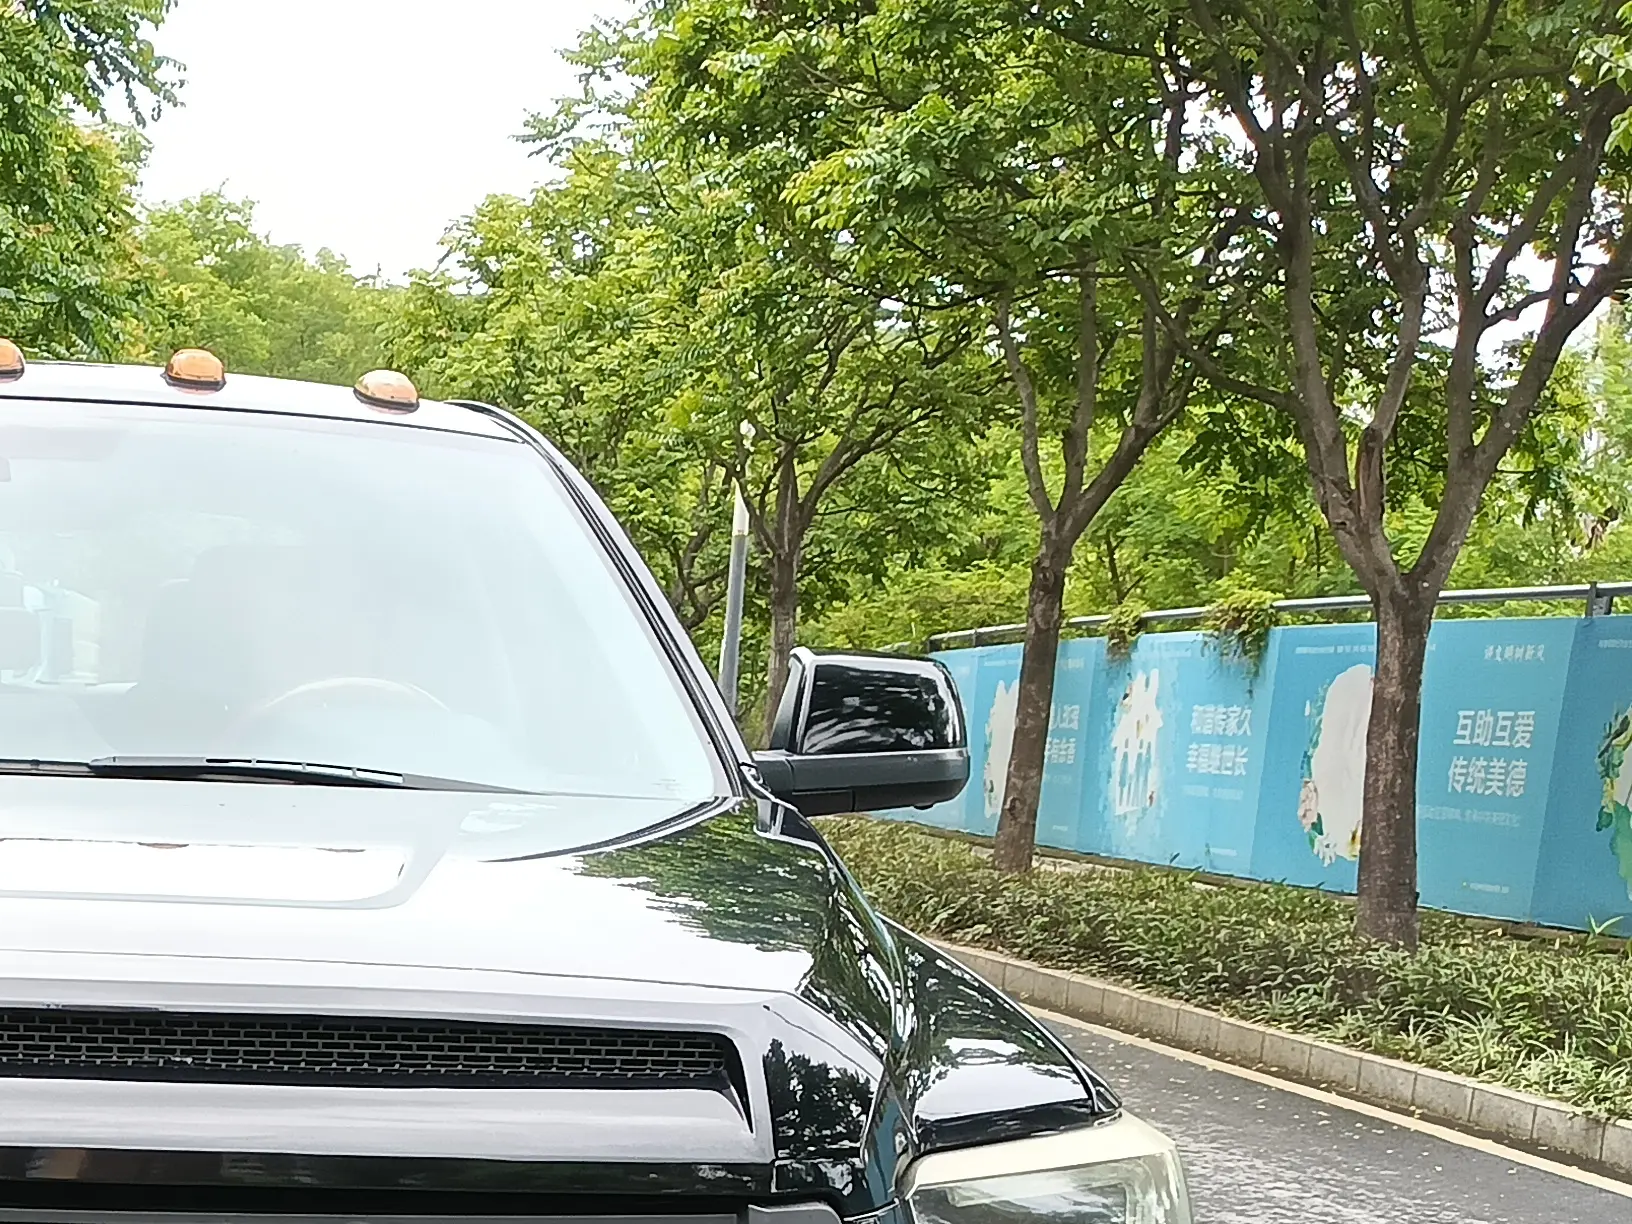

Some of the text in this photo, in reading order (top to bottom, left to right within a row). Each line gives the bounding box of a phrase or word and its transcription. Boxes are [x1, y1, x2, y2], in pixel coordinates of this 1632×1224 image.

[1453, 709, 1535, 748] 互助互爱
[1448, 756, 1528, 797] 传统美德
